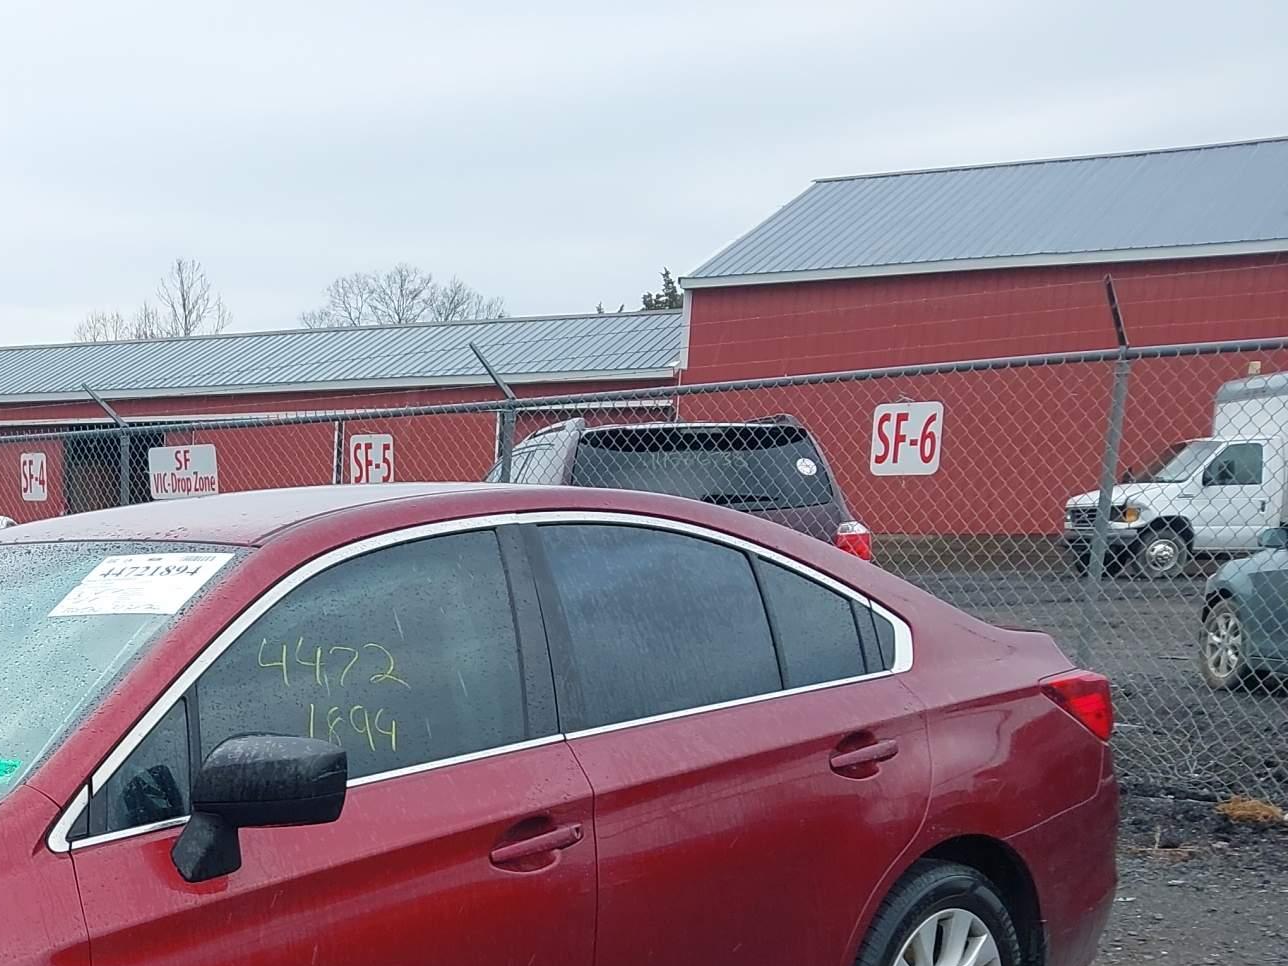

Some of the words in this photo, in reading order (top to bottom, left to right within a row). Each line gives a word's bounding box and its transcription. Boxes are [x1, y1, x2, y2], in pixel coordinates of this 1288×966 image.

[874, 412, 938, 465] SF-6
[22, 459, 46, 494] SF-4
[174, 449, 191, 471] SF
[353, 442, 392, 484] SF-5
[153, 471, 192, 496] VIC-Drop
[192, 471, 216, 492] Zone
[99, 564, 203, 579] 44721894
[257, 636, 412, 690] 4472
[309, 703, 397, 752] 1894
